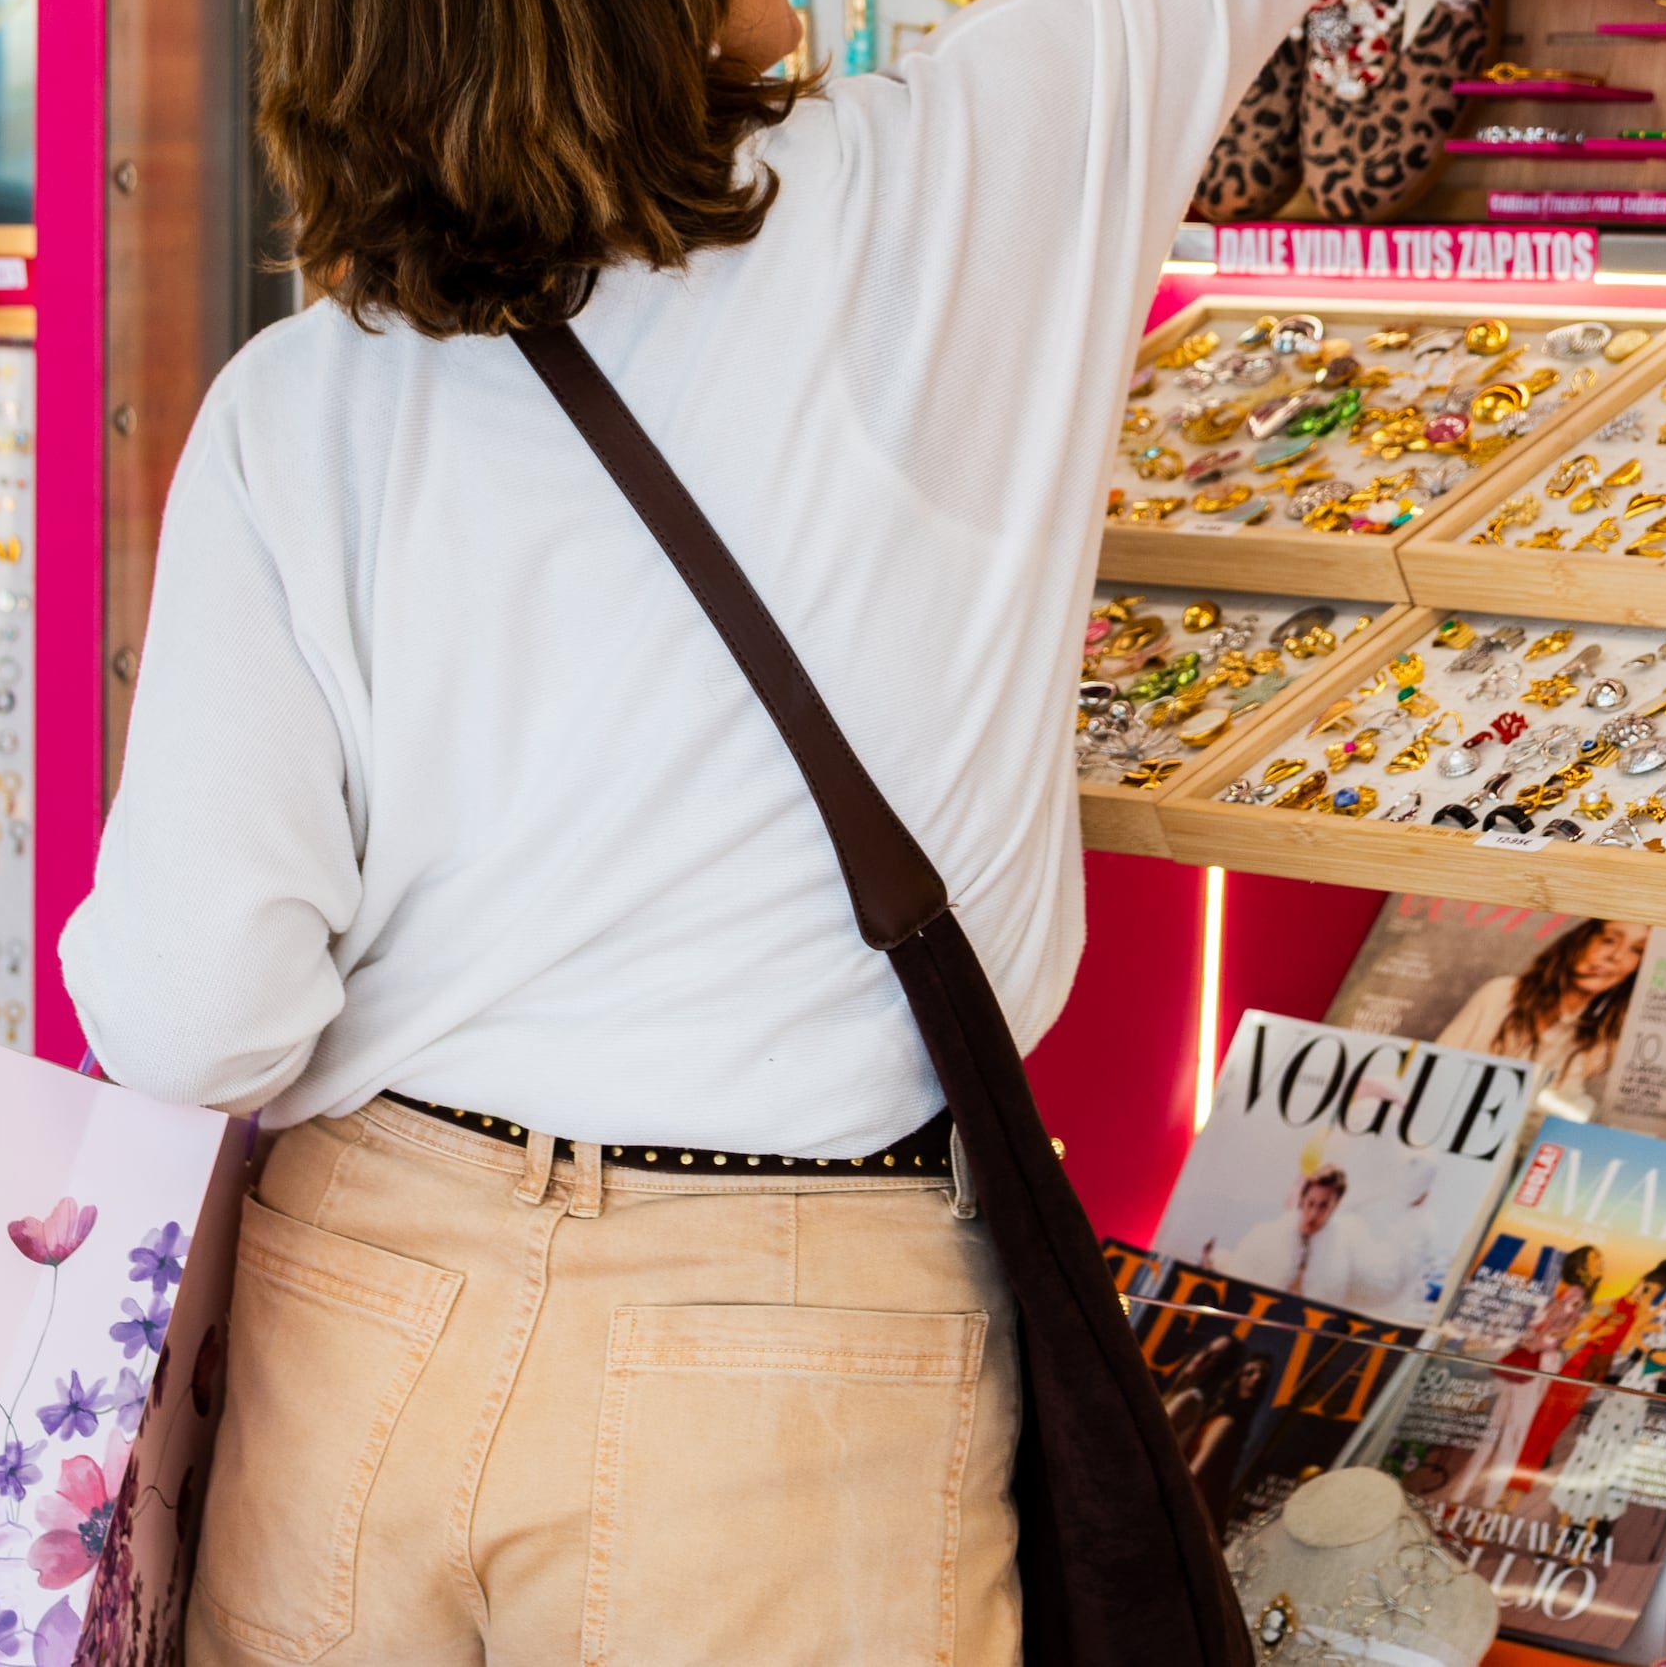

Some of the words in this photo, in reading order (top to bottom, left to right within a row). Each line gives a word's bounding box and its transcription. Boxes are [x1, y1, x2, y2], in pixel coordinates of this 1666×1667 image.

[1219, 226, 1289, 276] DALE
[1290, 227, 1364, 278] VIDA
[1366, 228, 1391, 278] A
[1392, 229, 1455, 280] TUS
[1456, 229, 1595, 282] ZAPATOS
[1244, 1024, 1526, 1162] VOGUE
